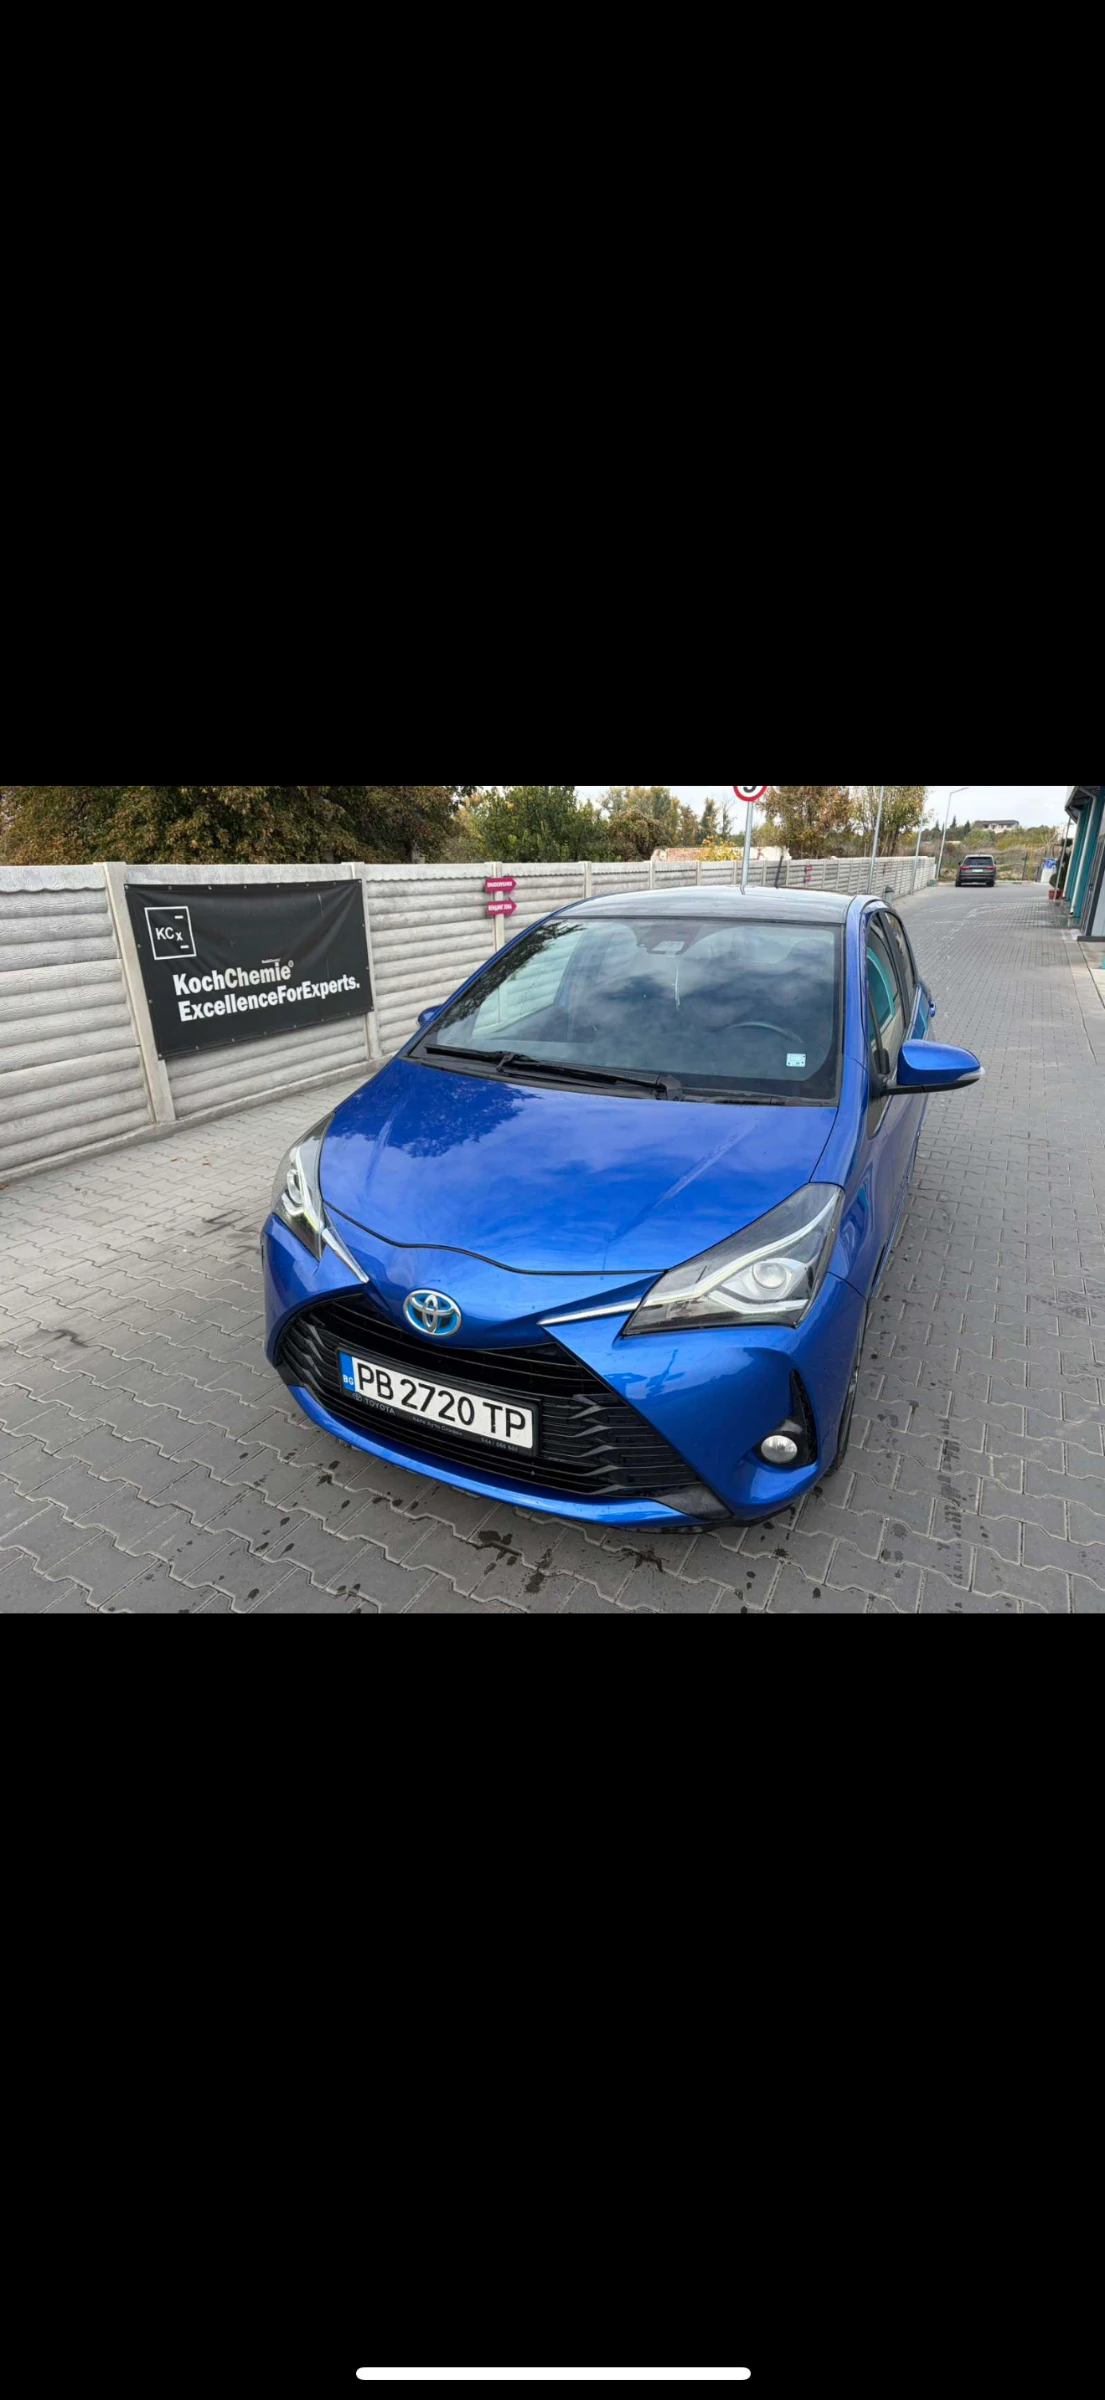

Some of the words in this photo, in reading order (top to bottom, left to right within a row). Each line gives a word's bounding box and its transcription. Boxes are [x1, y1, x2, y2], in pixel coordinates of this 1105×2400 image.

[177, 974, 361, 1022] ExcellenceForExperts.
[342, 1374, 354, 1386] BG
[364, 1398, 396, 1416] TOYOTA
[400, 1379, 475, 1426] 2720
